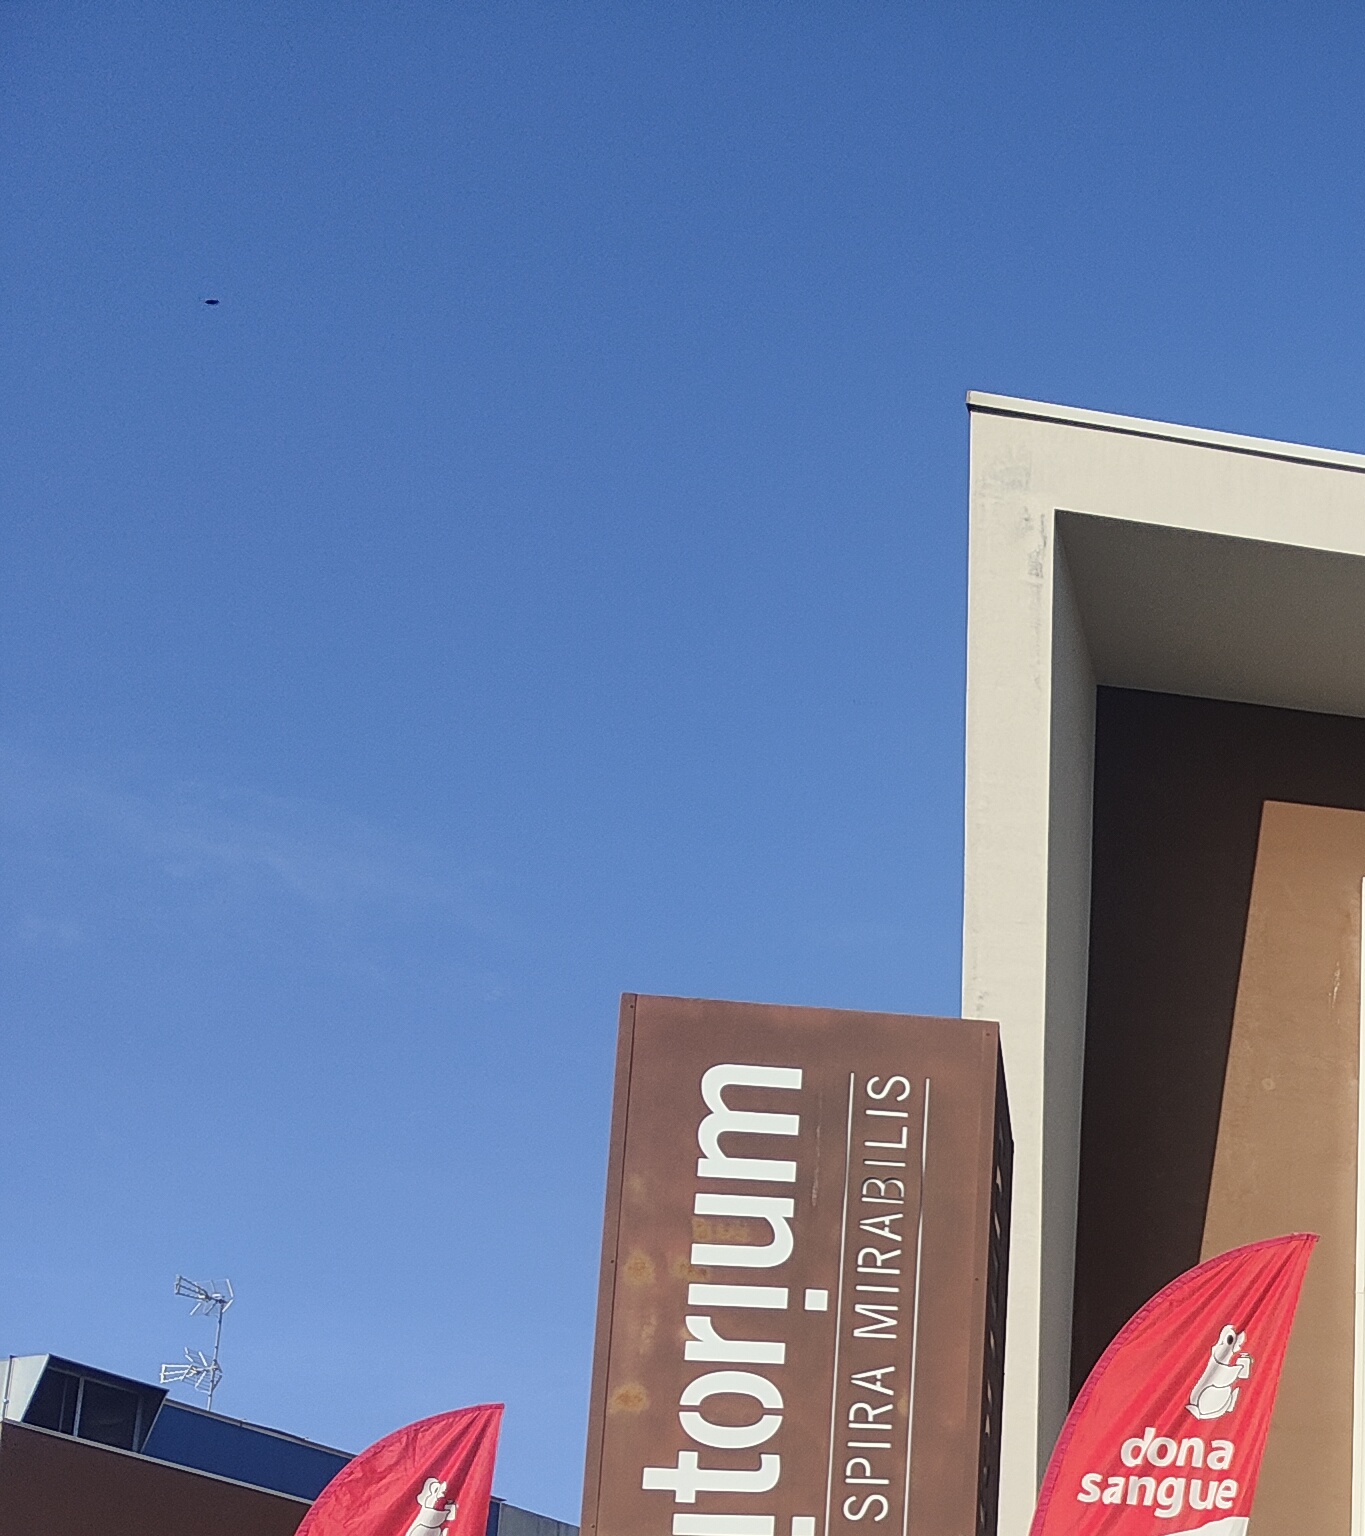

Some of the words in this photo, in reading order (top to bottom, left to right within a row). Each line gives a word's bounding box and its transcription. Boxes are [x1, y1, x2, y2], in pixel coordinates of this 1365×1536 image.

[852, 1074, 911, 1341] MIRABILIS
[844, 1364, 896, 1522] SPIRA
[1120, 1427, 1234, 1470] dona
[1077, 1471, 1238, 1518] sangue
